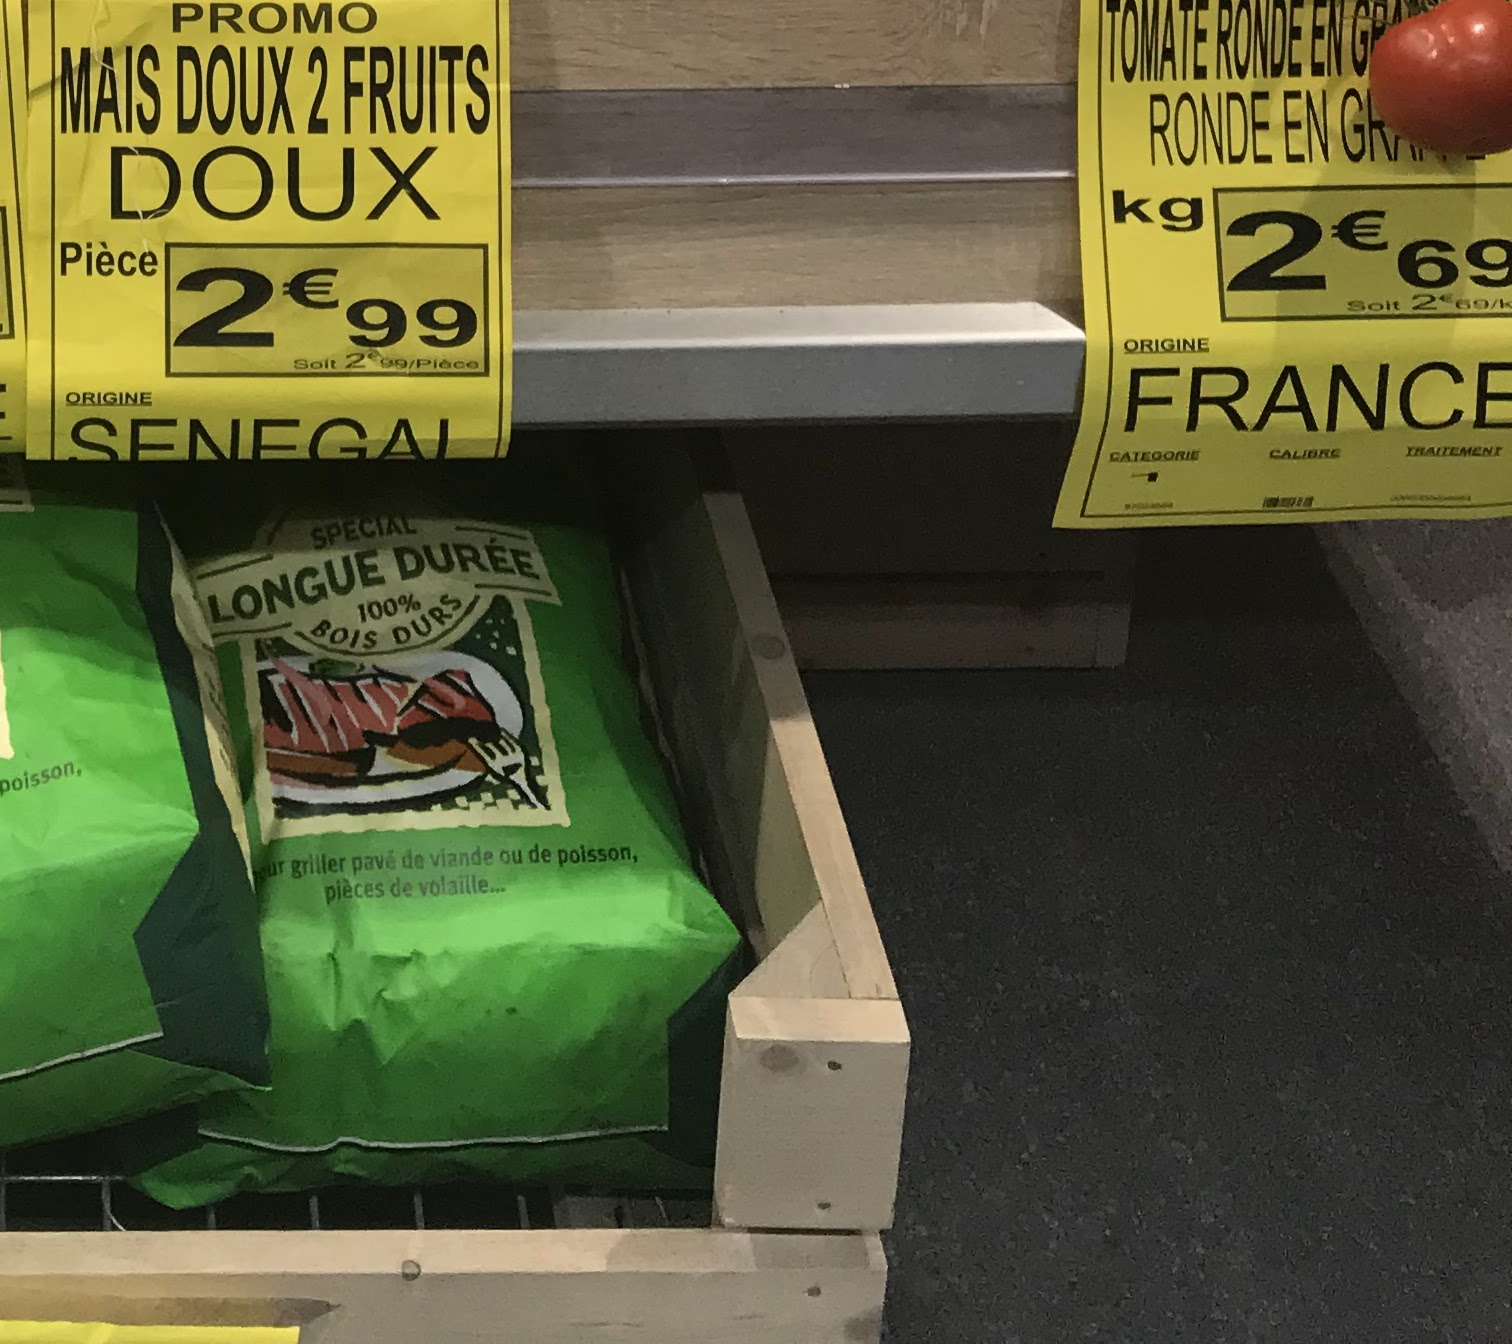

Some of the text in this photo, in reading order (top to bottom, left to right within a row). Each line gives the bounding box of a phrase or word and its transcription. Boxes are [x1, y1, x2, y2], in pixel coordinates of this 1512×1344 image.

[171, 2, 379, 34] PROMO
[59, 43, 490, 136] MAIS DOUX 2 FRUITS
[1149, 91, 1272, 166] RONDE
[1284, 91, 1330, 164] EN
[109, 146, 441, 221] DOUX
[1113, 190, 1203, 232] kg
[59, 241, 158, 278] Pièce
[1347, 294, 1512, 311] Soit 2€69/k
[1124, 338, 1209, 353] ORIGINE
[293, 357, 337, 372] Soit
[65, 391, 153, 407] ORIGINE
[1123, 361, 1512, 433] FRANCE
[1406, 446, 1503, 459] TRAITEMENT
[207, 538, 540, 624] LONGUE DURÉE
[311, 594, 462, 650] BOIS DURS
[358, 593, 421, 623] 100%
[290, 842, 638, 880] griller pavé de viande ou de poisson,
